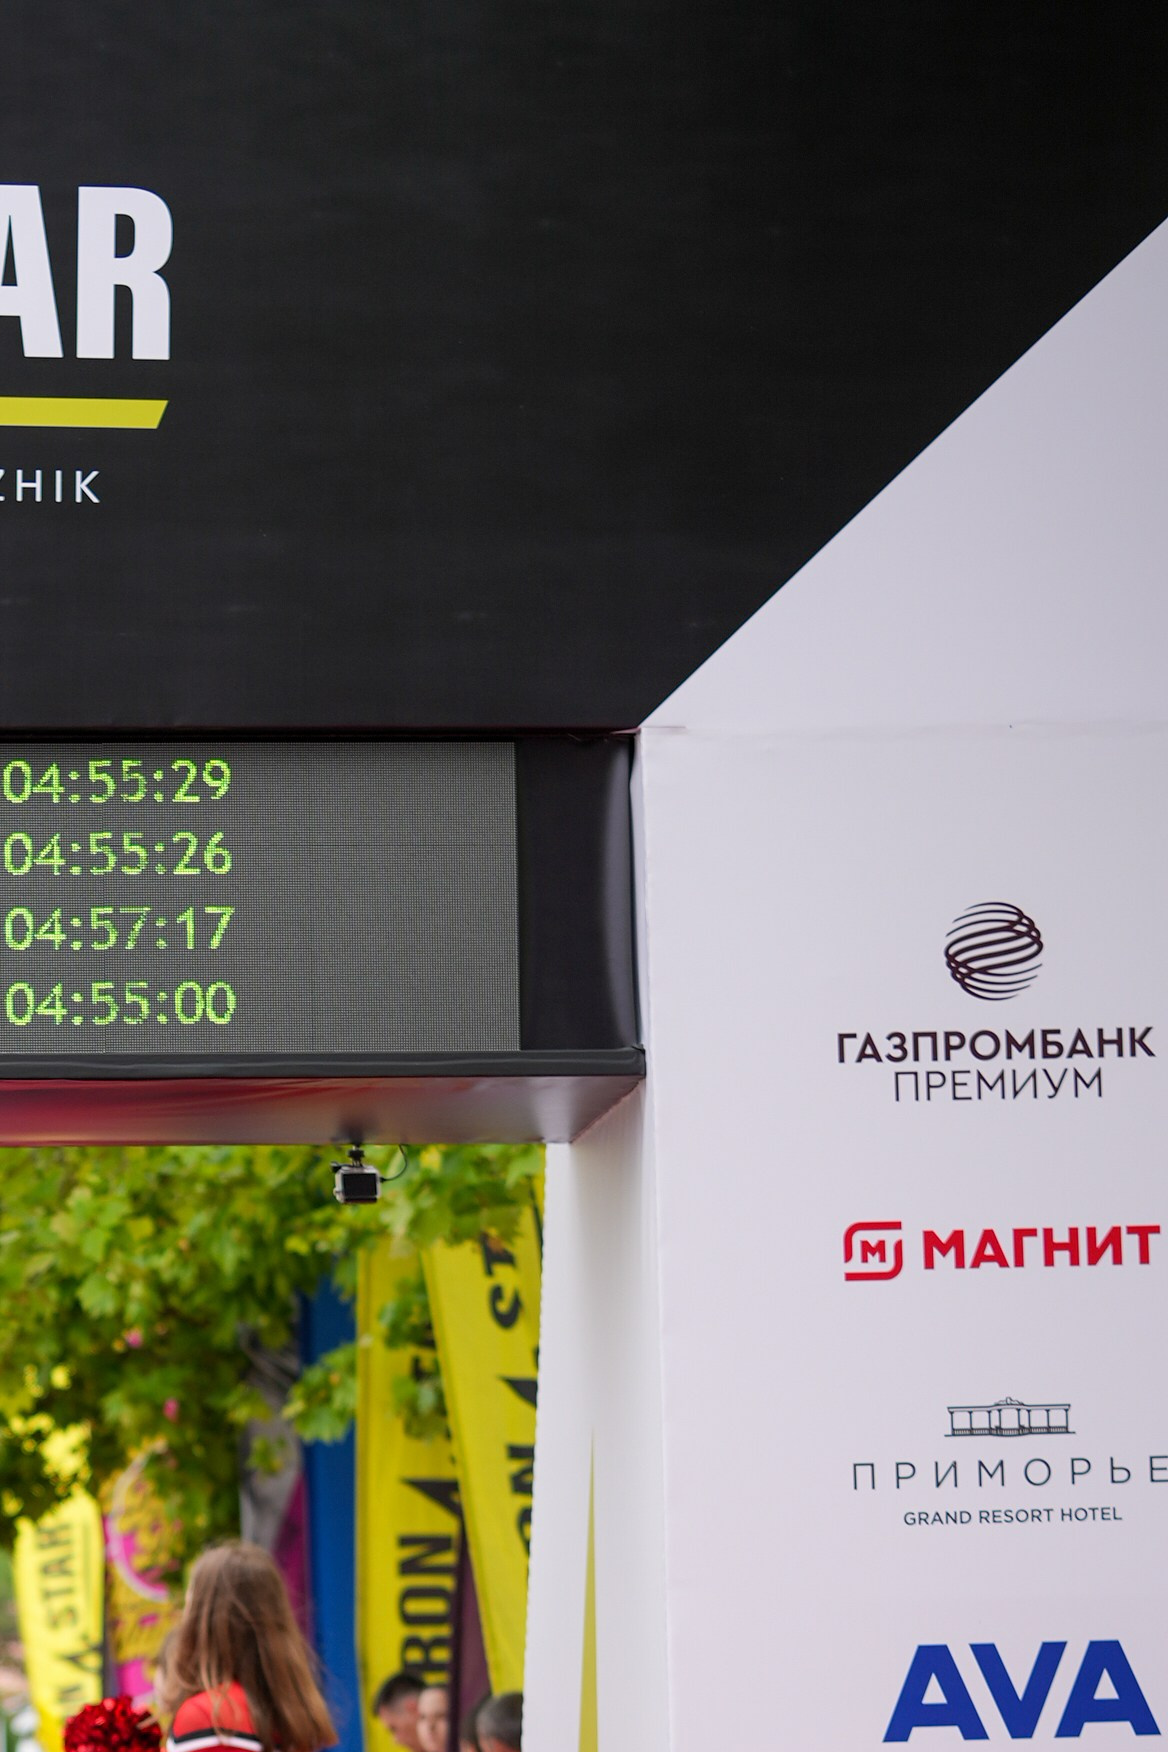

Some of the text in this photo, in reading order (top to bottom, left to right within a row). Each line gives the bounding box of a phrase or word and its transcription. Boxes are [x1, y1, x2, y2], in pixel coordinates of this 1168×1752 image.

[2, 758, 231, 803] 04:55:29
[3, 832, 232, 875] 04:55:26
[4, 905, 234, 950] 04:57:17
[5, 980, 237, 1026] 04:55:00
[837, 1026, 1156, 1064] ГАЗПРОМБАНК
[894, 1067, 1103, 1102] ПРЕМИУМ
[923, 1224, 1161, 1270] МАГНИТ
[852, 1455, 1168, 1491] ПРИМОРЬЕ
[903, 1506, 1123, 1526] GRAND RESORT HOTEL
[398, 1534, 453, 1690] RON
[882, 1639, 1162, 1743] AVA
